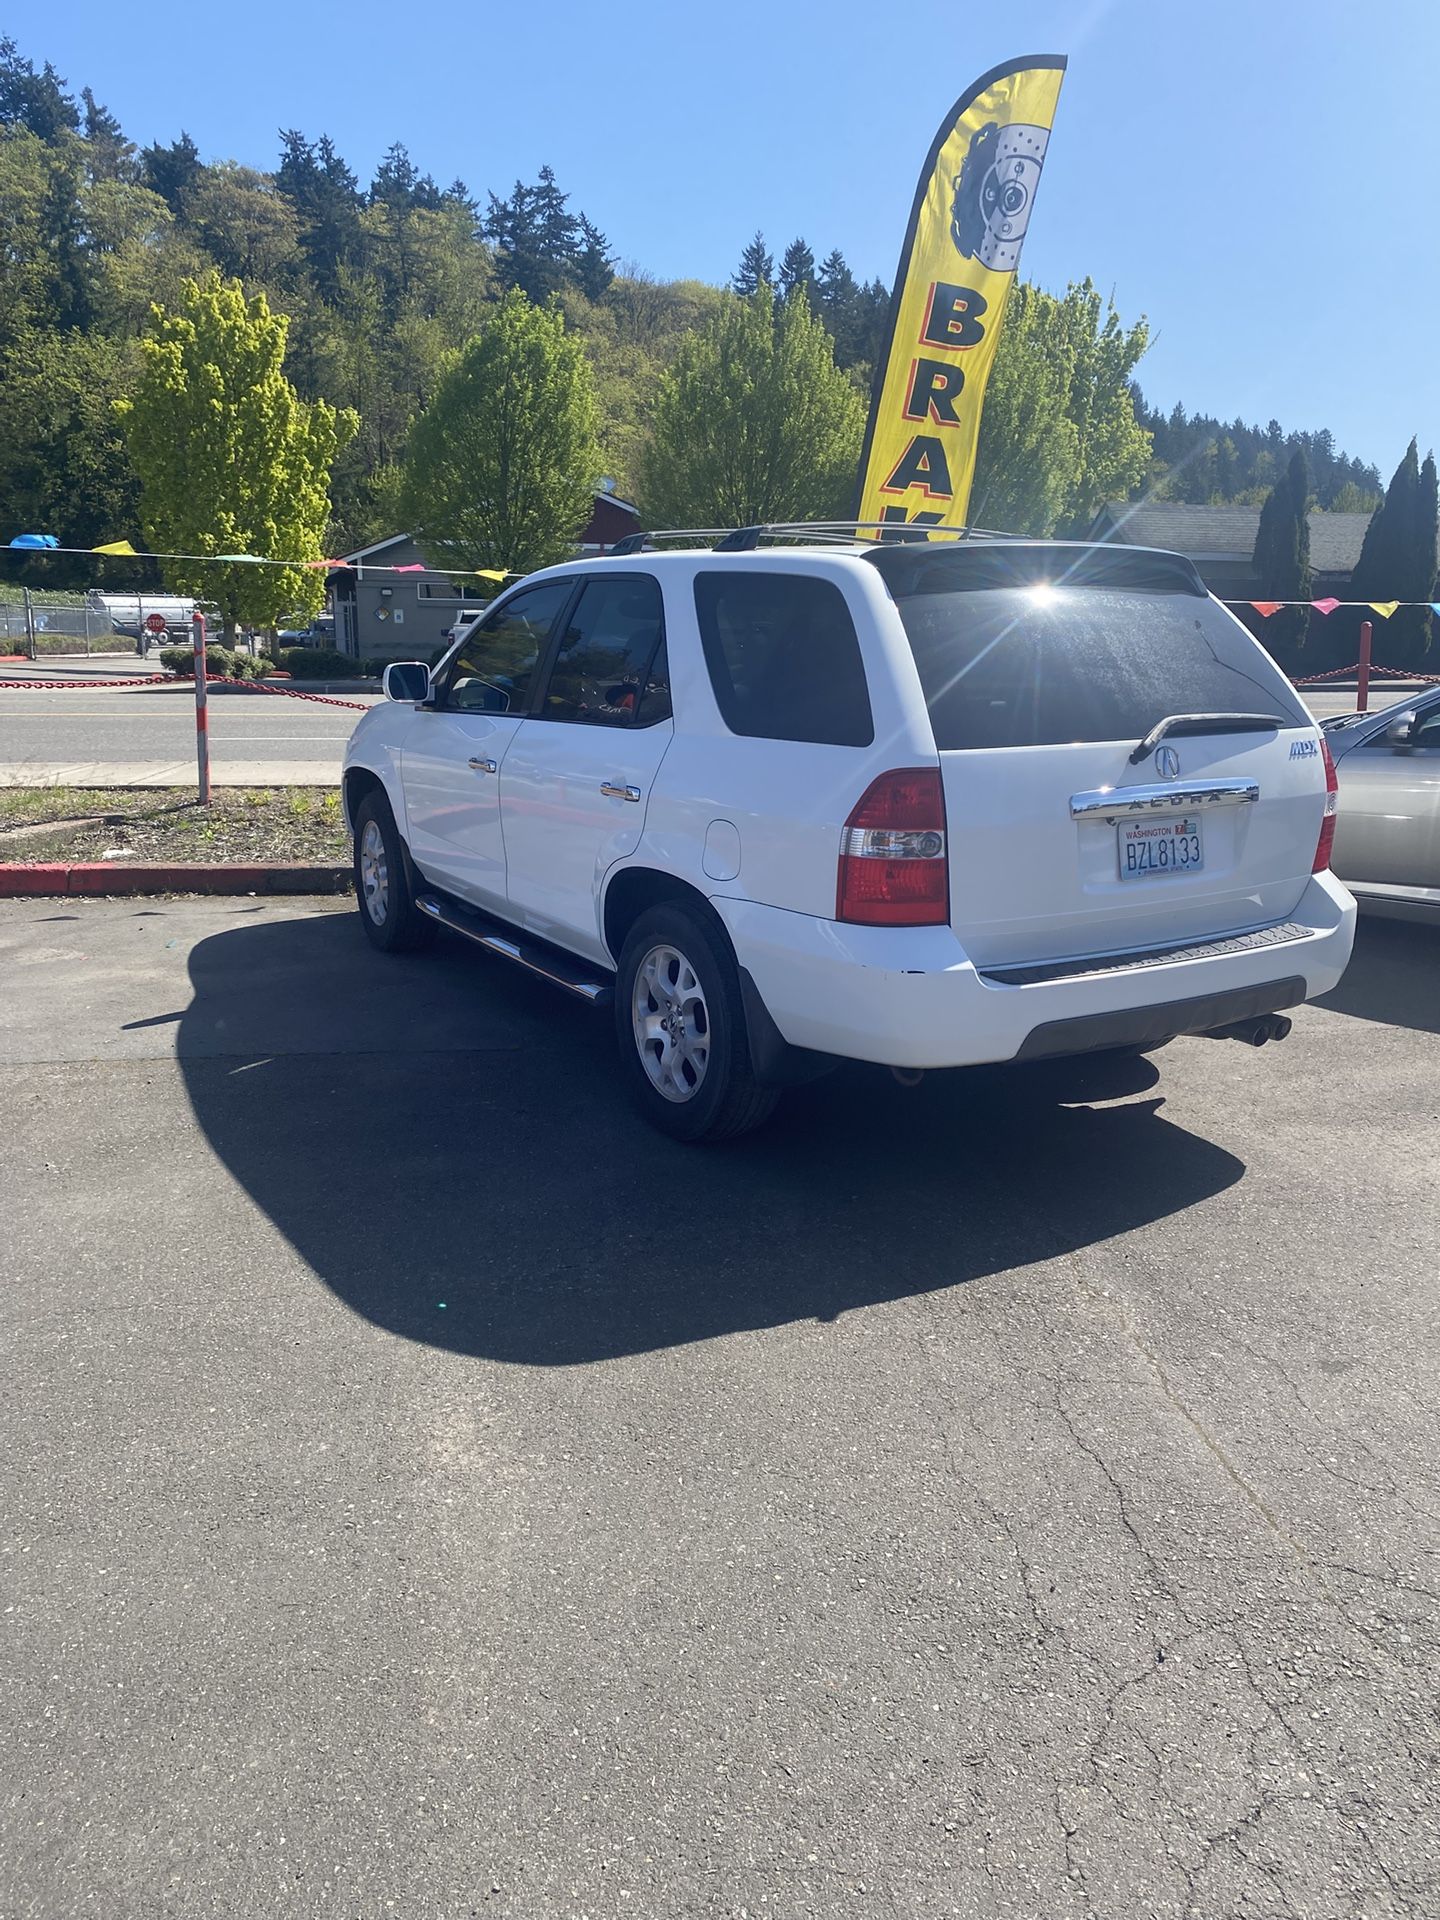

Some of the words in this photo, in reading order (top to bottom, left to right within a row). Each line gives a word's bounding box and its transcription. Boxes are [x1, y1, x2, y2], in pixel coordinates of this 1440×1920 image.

[1290, 741, 1318, 756] MDX
[1129, 792, 1221, 810] ACURA
[1126, 827, 1172, 840] WASHINGTON
[1127, 836, 1200, 871] BZL8133
